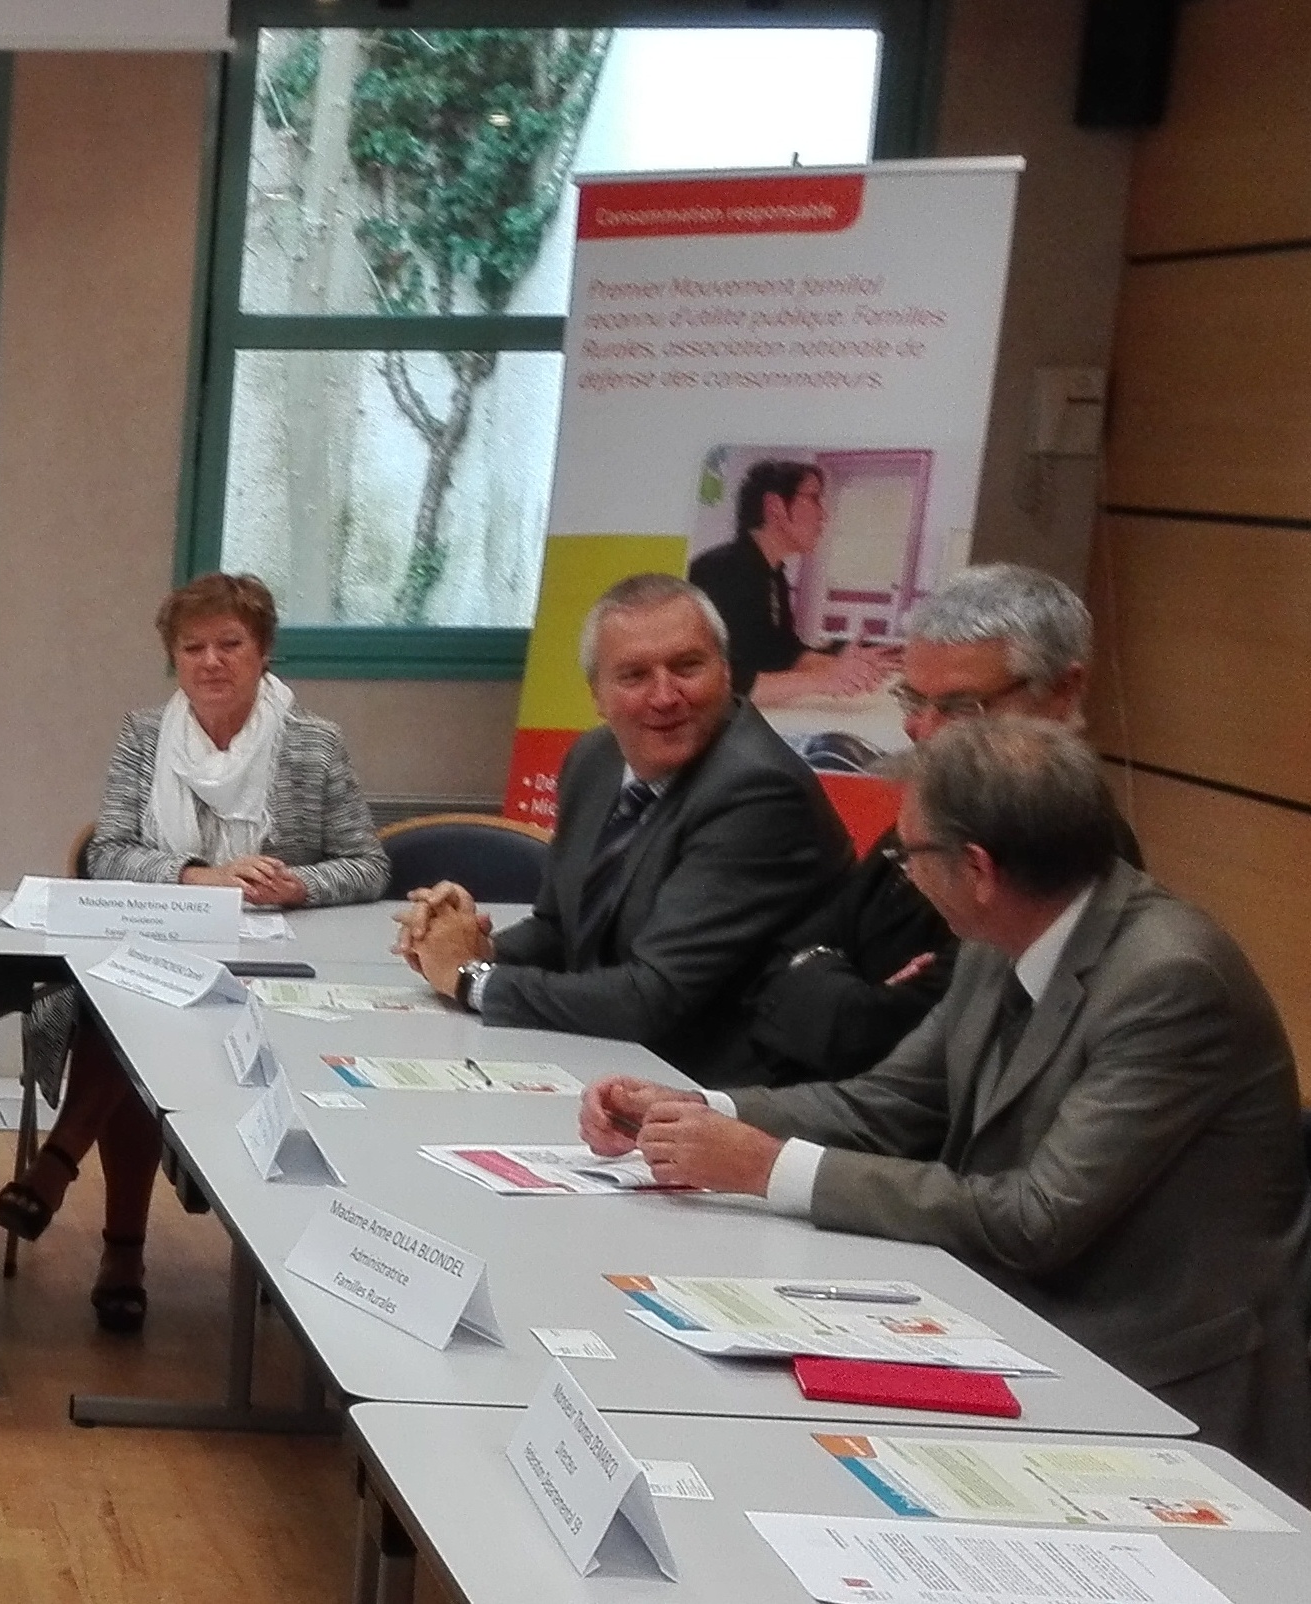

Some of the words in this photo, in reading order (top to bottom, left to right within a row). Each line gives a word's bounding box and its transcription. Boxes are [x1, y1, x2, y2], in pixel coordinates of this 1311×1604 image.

[78, 895, 124, 910] Madame
[329, 1199, 369, 1231] Madame
[369, 1218, 393, 1242] Anne
[392, 1228, 418, 1255] OLLA
[416, 1242, 465, 1279] BLONDEL
[349, 1246, 410, 1288] Administratrice
[333, 1271, 369, 1301] Familles
[366, 1288, 398, 1315] Rurales
